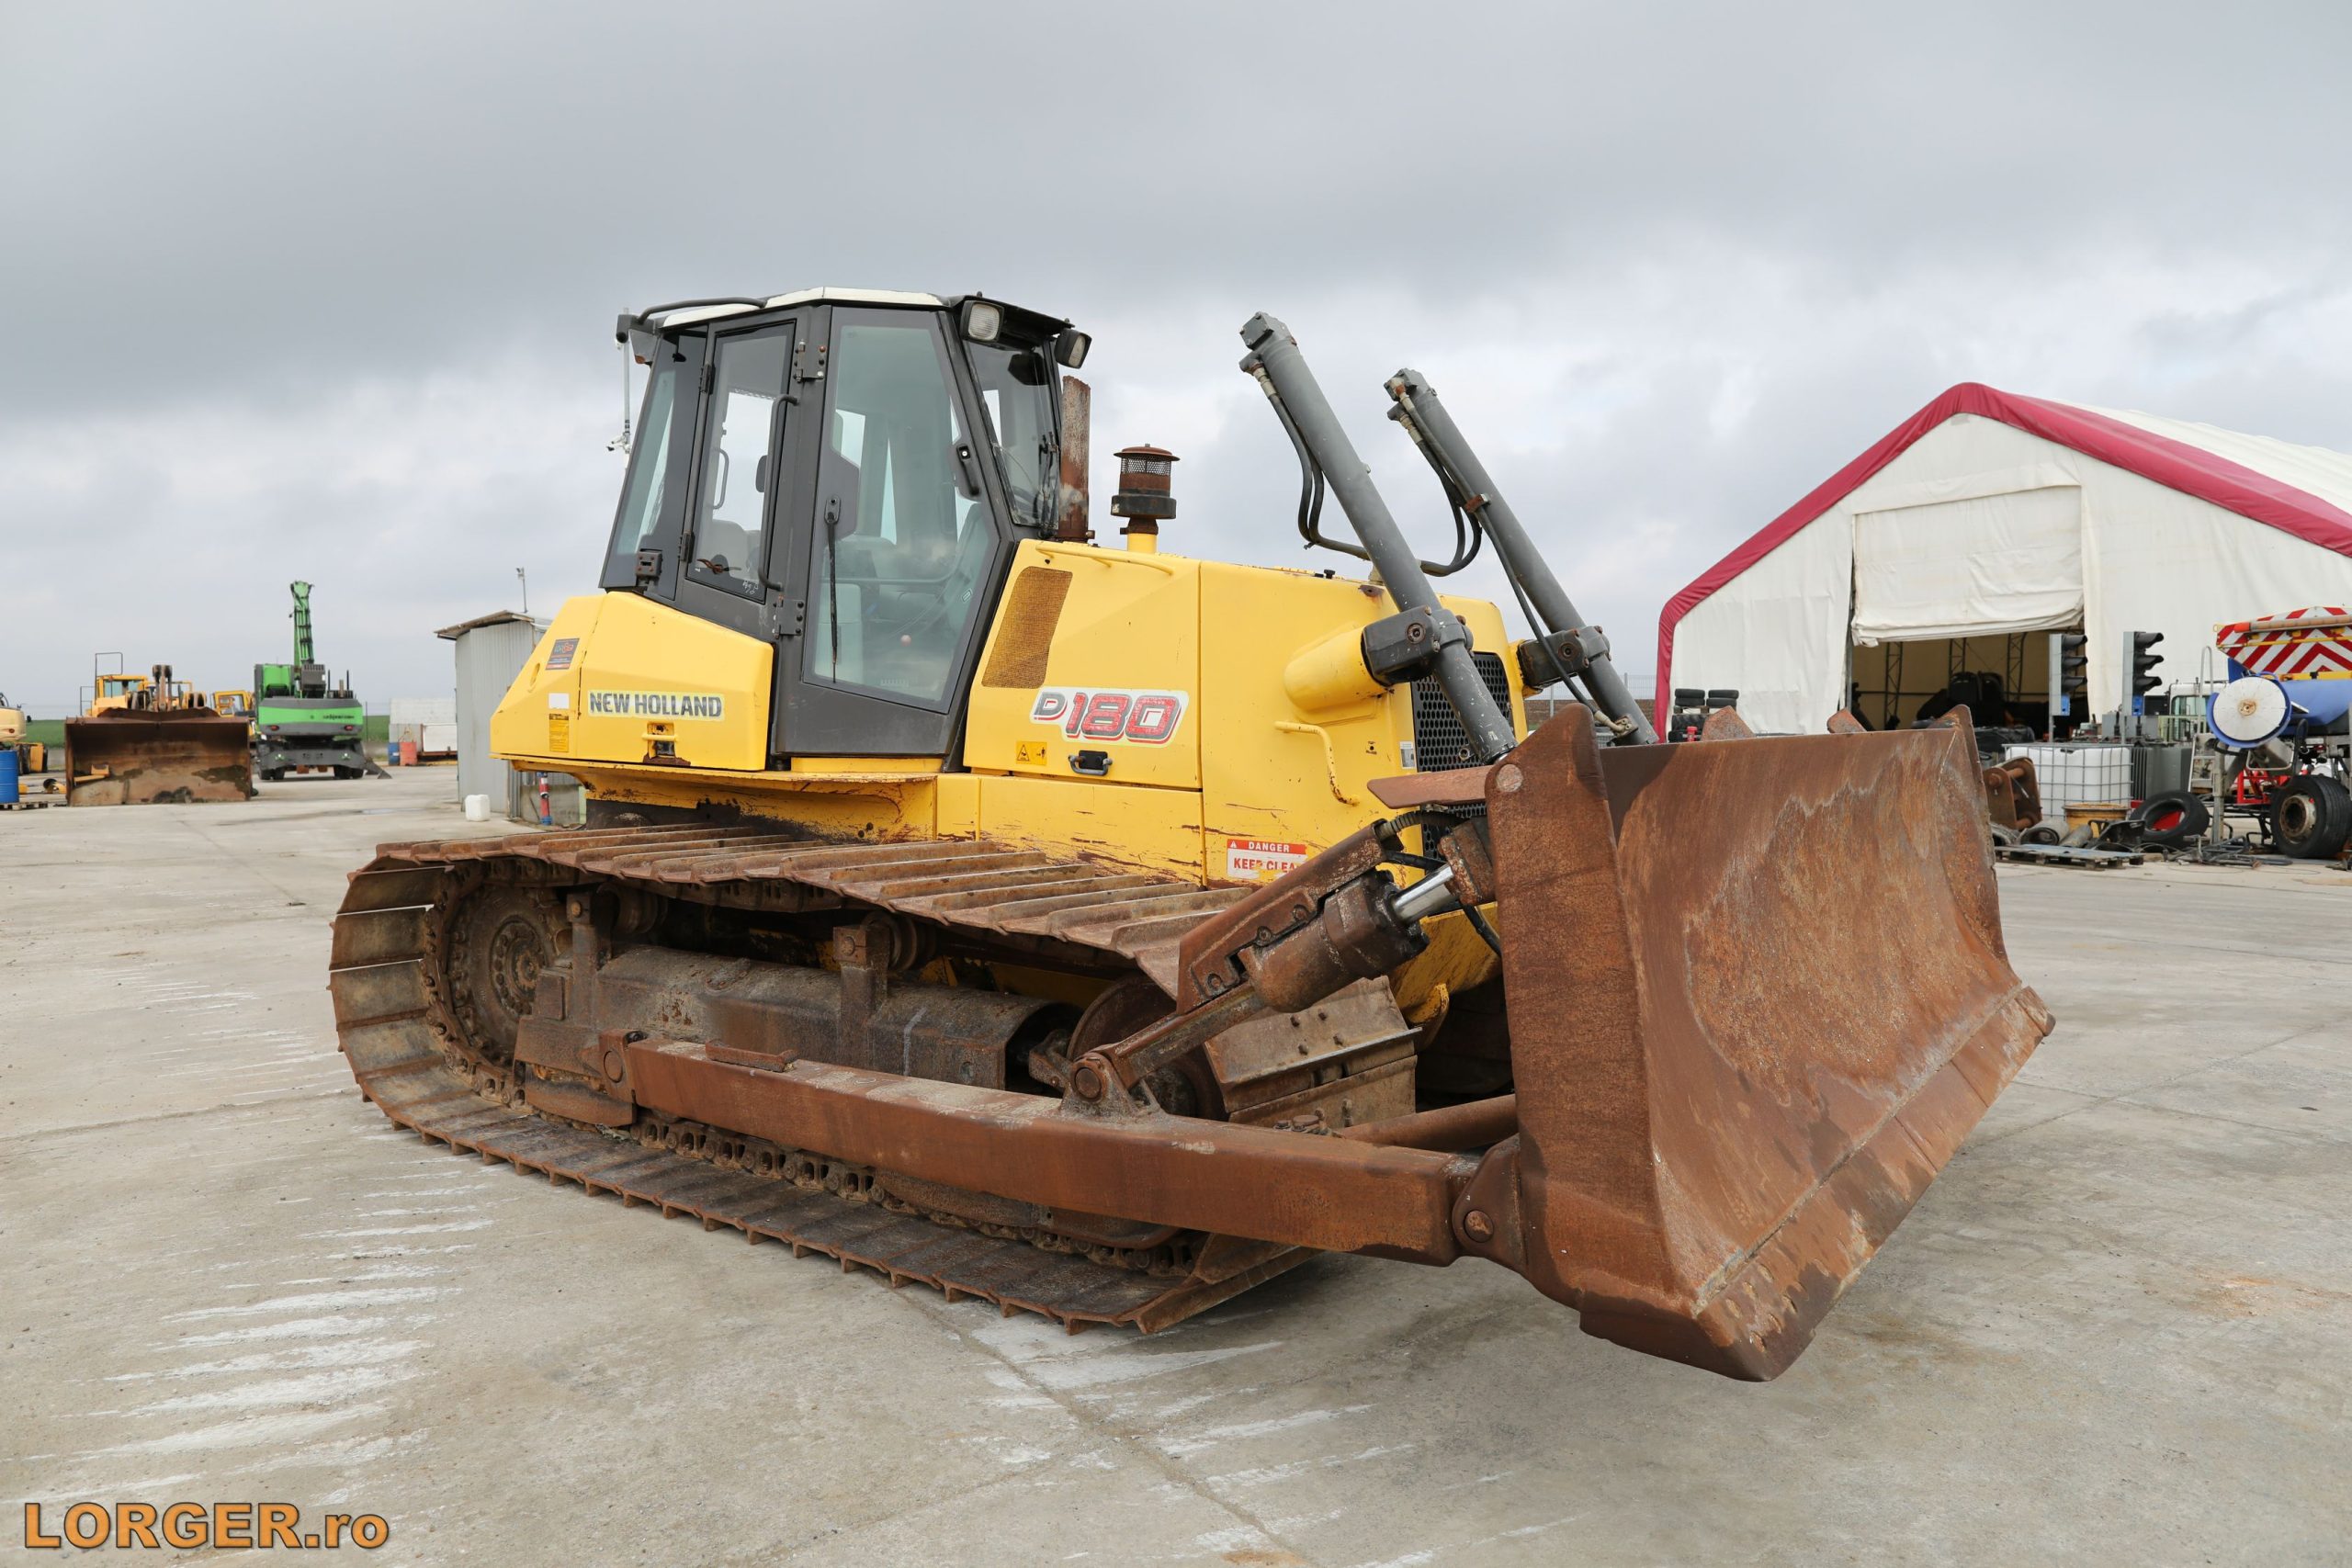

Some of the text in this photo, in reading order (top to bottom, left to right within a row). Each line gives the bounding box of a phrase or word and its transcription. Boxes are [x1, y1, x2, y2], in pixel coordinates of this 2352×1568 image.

[589, 693, 722, 717] NEW HOLLAND
[1034, 692, 1182, 745] D180
[1249, 841, 1290, 852] DANGER
[1266, 861, 1296, 873] CLEA
